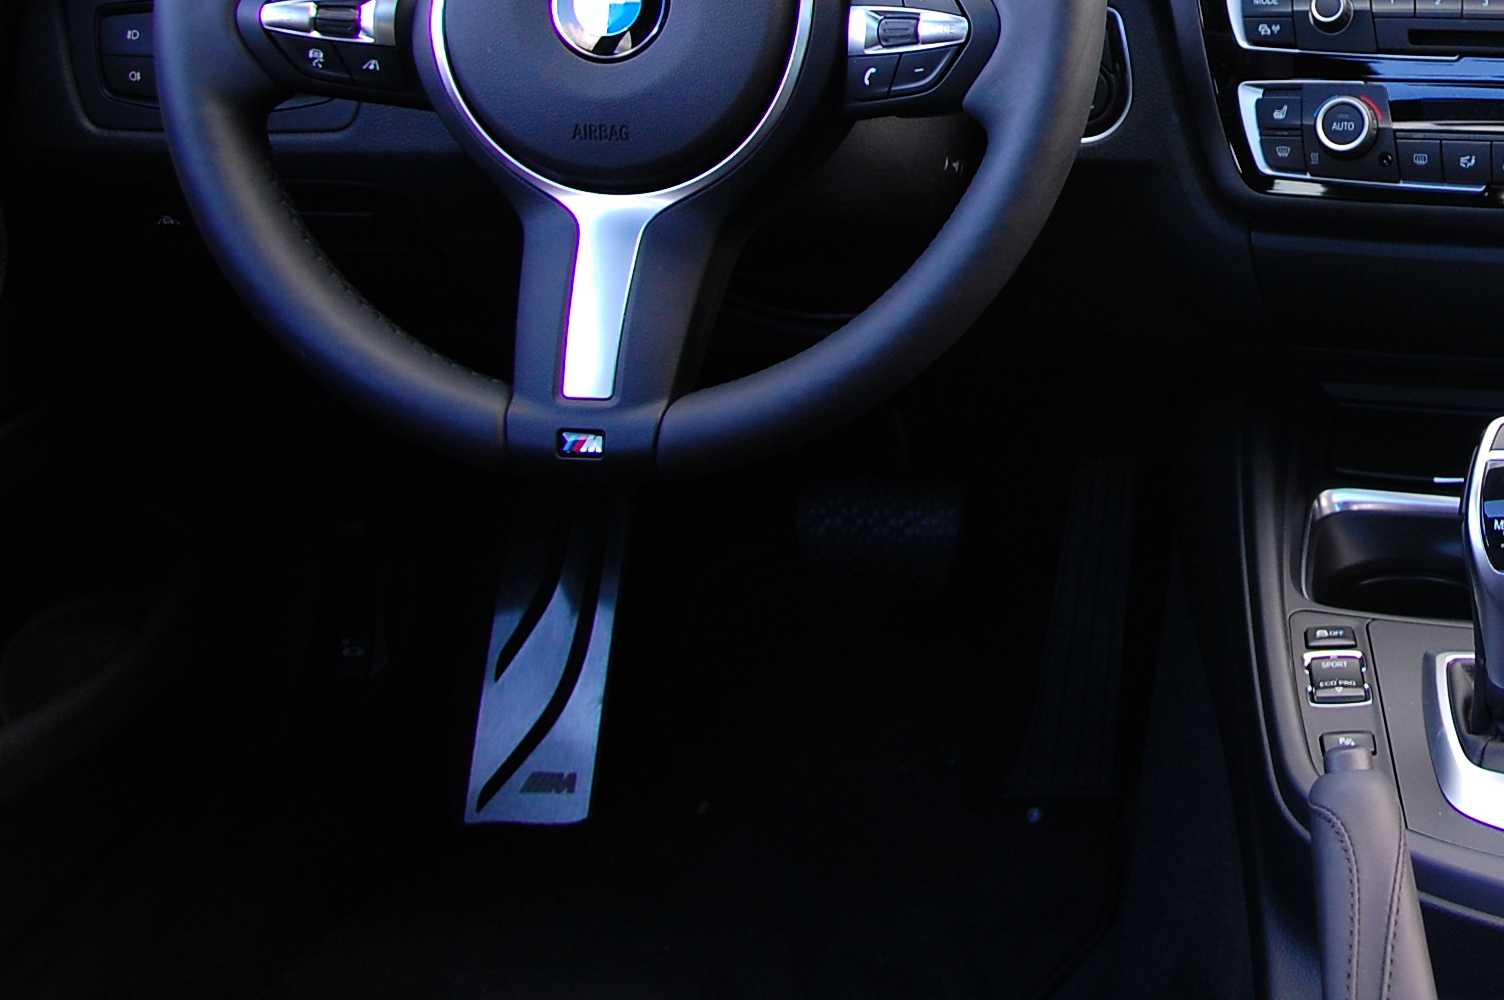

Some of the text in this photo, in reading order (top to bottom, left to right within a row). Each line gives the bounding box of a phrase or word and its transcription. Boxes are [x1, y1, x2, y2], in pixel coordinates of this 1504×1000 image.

[1331, 121, 1355, 131] AUTO
[572, 123, 630, 141] AIRBAG
[1321, 660, 1347, 668] SPORT
[1319, 679, 1337, 687] ECO
